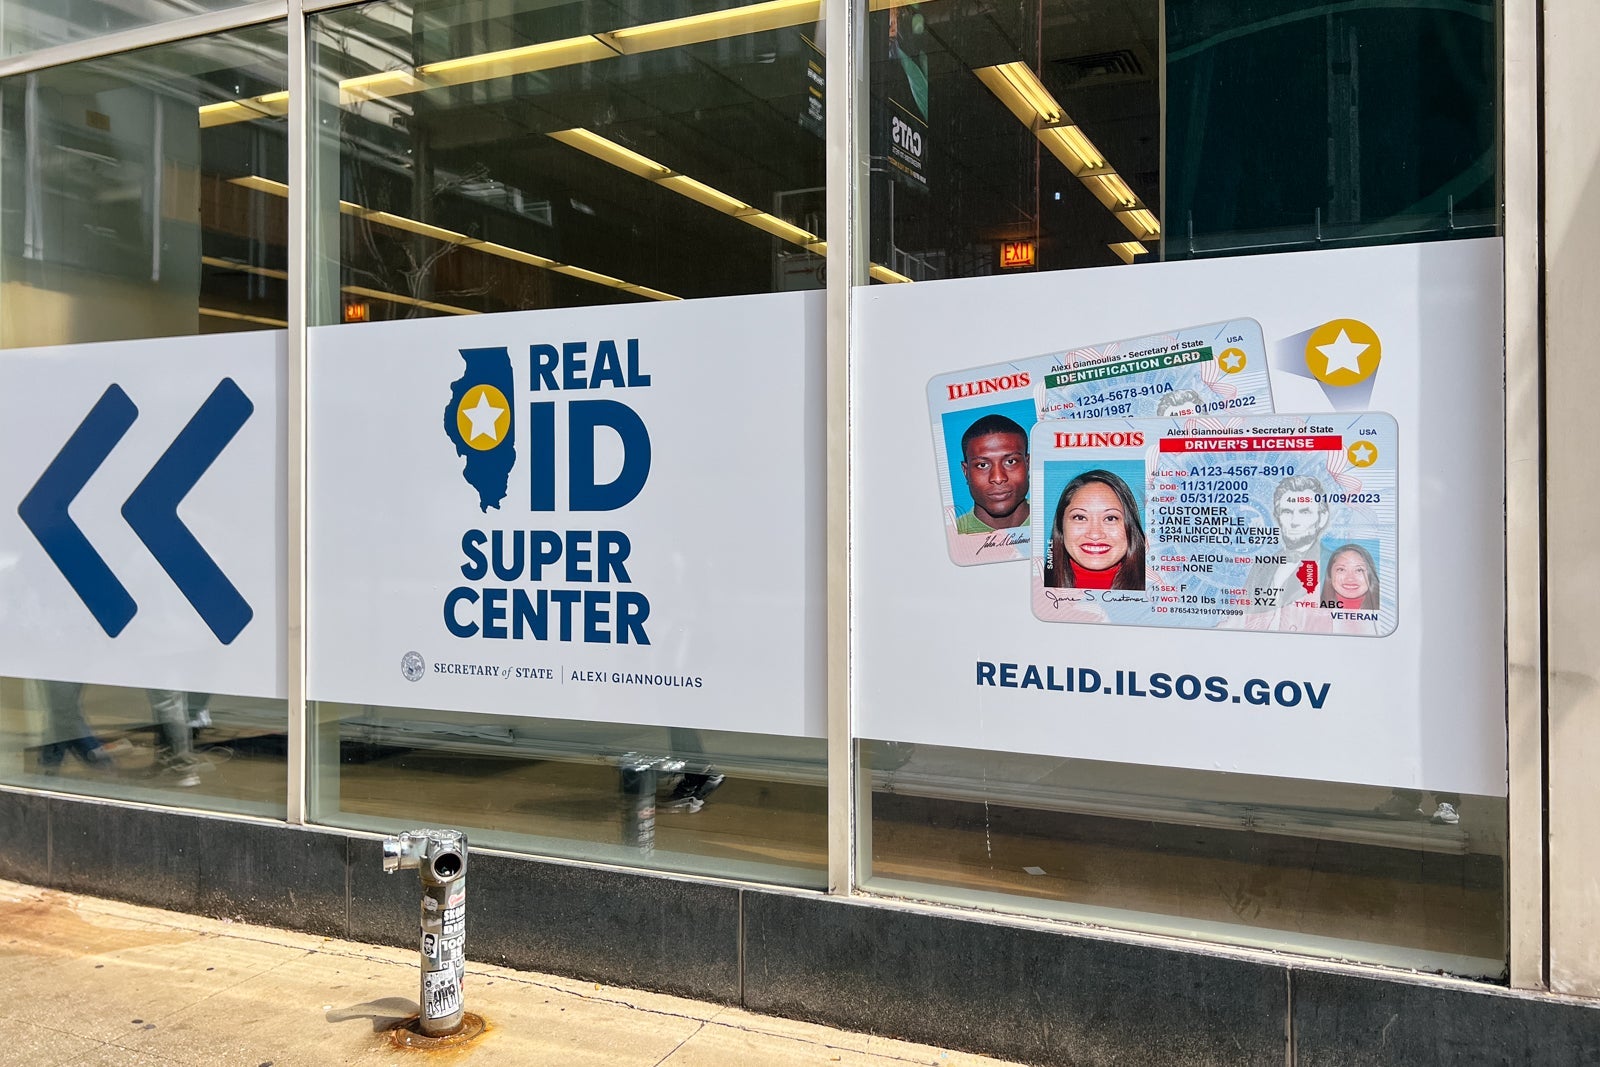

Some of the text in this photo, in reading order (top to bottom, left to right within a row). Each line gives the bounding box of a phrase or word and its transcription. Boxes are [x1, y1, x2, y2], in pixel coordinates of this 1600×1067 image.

[1004, 242, 1029, 261] EXIT
[1226, 335, 1244, 344] USA
[1051, 340, 1204, 373] Alexi Giannoulias Secretary of State
[530, 339, 651, 391] REAL
[1056, 351, 1201, 385] IDENTIFICATION CARD
[947, 372, 1031, 400] ILLINOIS
[1077, 382, 1174, 407] 1234-5678-910A
[1195, 396, 1256, 413] 01/09/2022
[1069, 403, 1132, 419] 11/30/1987
[1167, 428, 1189, 436] Alexi
[1191, 427, 1244, 436] Giannoulias
[1252, 426, 1295, 435] Secretary
[1298, 426, 1307, 434] of
[1054, 432, 1145, 448] ILLINOIS
[1253, 438, 1314, 449] LICENSE
[530, 399, 651, 512] ID
[1190, 465, 1295, 477] A123-4567-8910
[1180, 481, 1248, 491] 11/31/2000
[1180, 493, 1249, 503] 05/31/2025
[1314, 494, 1381, 503] 01/09/2023
[1159, 506, 1227, 516] CUSTOMER
[1158, 516, 1191, 526] JANE
[1194, 517, 1245, 526] SAMPLE
[1185, 527, 1234, 535] LINCOLN
[1235, 527, 1280, 536] AVENUE
[1159, 535, 1279, 545] SPRINGFIELD, IL 62723
[460, 529, 632, 583] SUPER
[1190, 555, 1223, 563] AEIOU
[1255, 556, 1287, 564] NONE
[1182, 564, 1214, 573] NONE
[1306, 563, 1314, 587] DONOR
[1180, 584, 1187, 592] F
[1181, 595, 1198, 603] 120
[1201, 595, 1216, 604] lbs
[1254, 598, 1276, 606] XYZ
[1320, 600, 1344, 609] ABC
[443, 586, 651, 645] CENTER
[1330, 611, 1378, 621] VETERAN
[434, 663, 499, 677] SECRETARY
[501, 666, 513, 680] of
[515, 667, 553, 680] STATE
[571, 671, 703, 688] ALEXI GIANNOULIAS
[976, 661, 1331, 709] REALID.ILSOS.GOV
